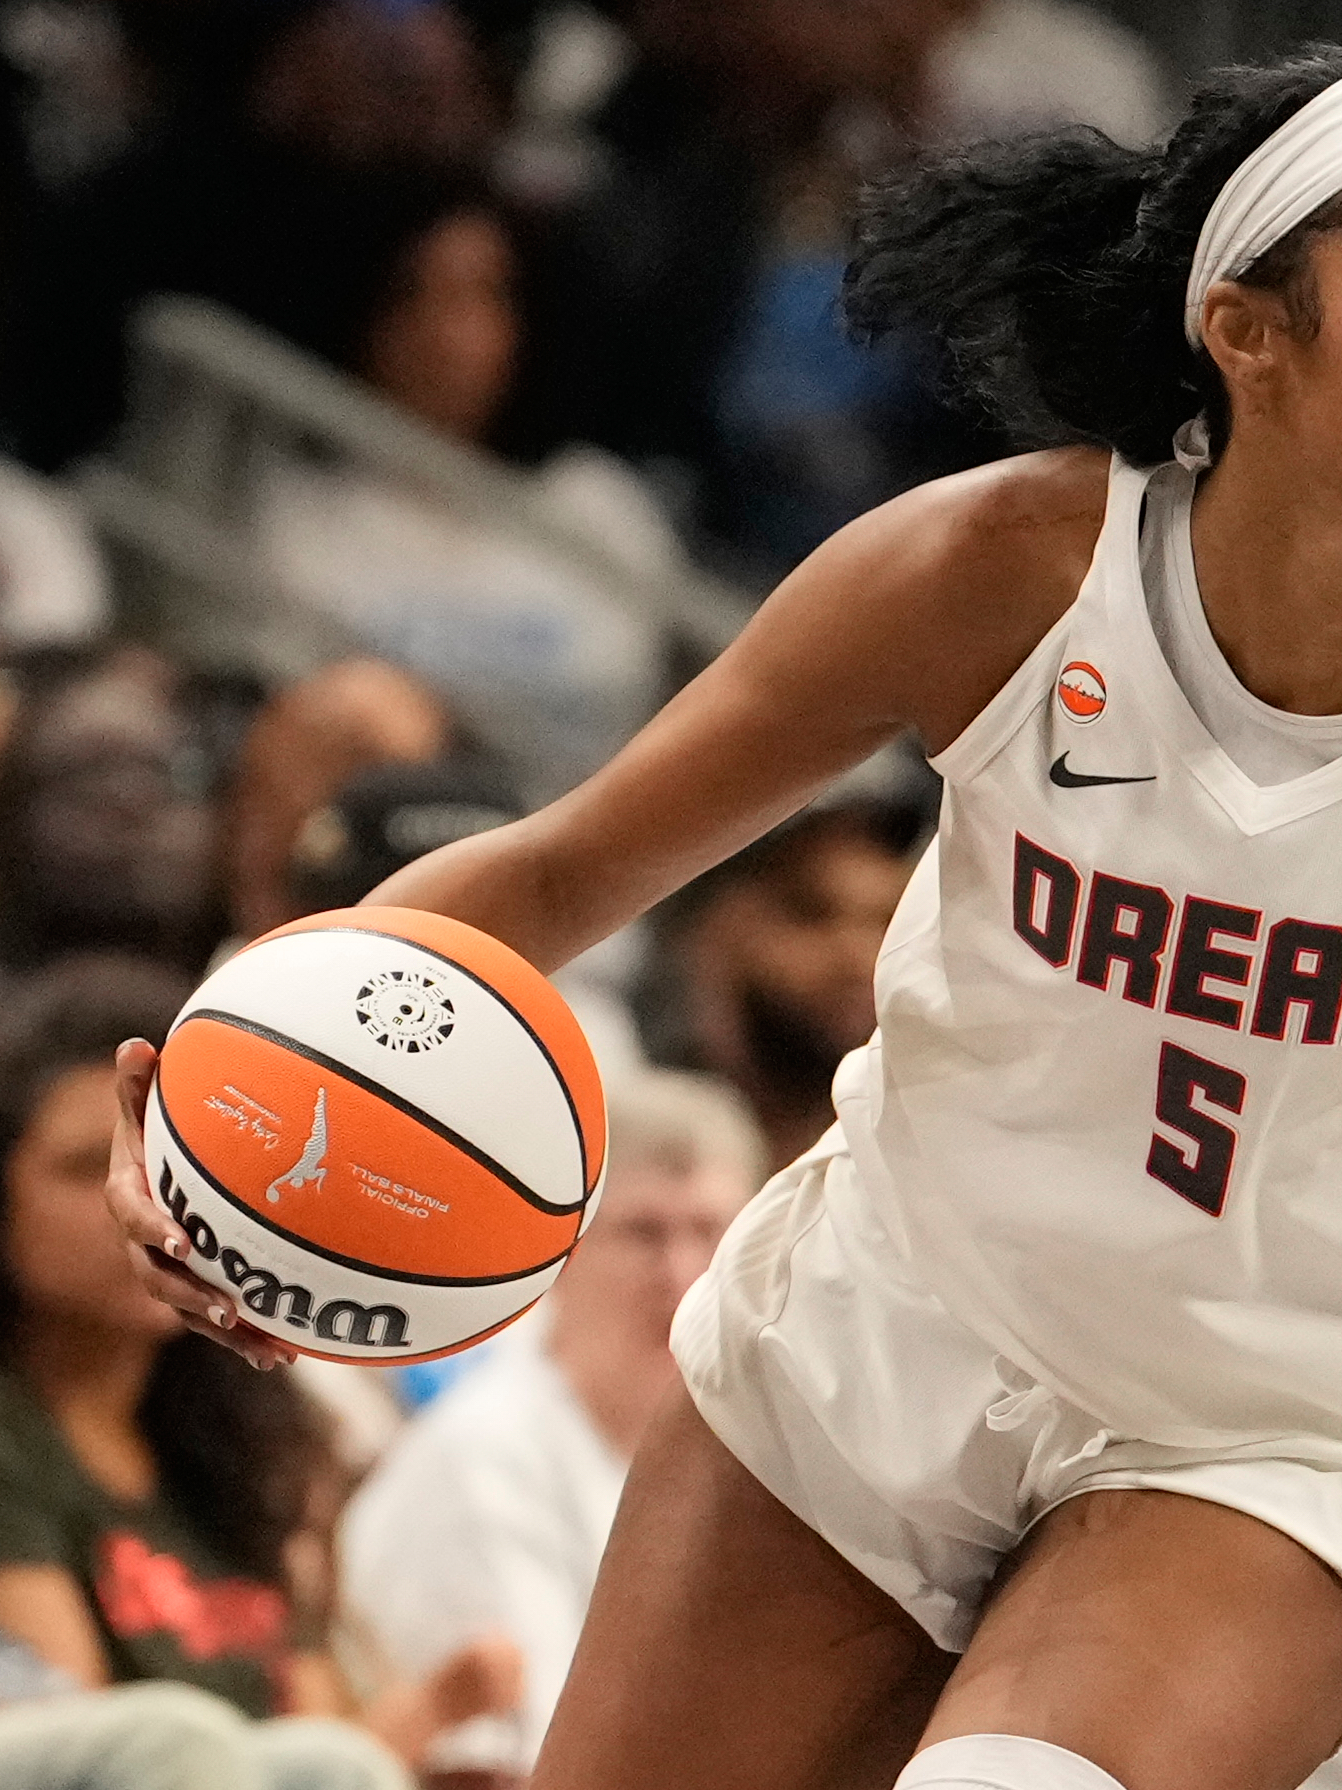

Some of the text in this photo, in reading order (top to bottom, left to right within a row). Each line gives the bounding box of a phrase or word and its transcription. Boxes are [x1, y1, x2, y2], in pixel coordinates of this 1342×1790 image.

[1146, 1038, 1248, 1218] 5
[347, 1162, 450, 1213] FINALS BALL
[358, 1181, 429, 1219] OFFICIAL
[159, 1154, 413, 1348] Wilson
